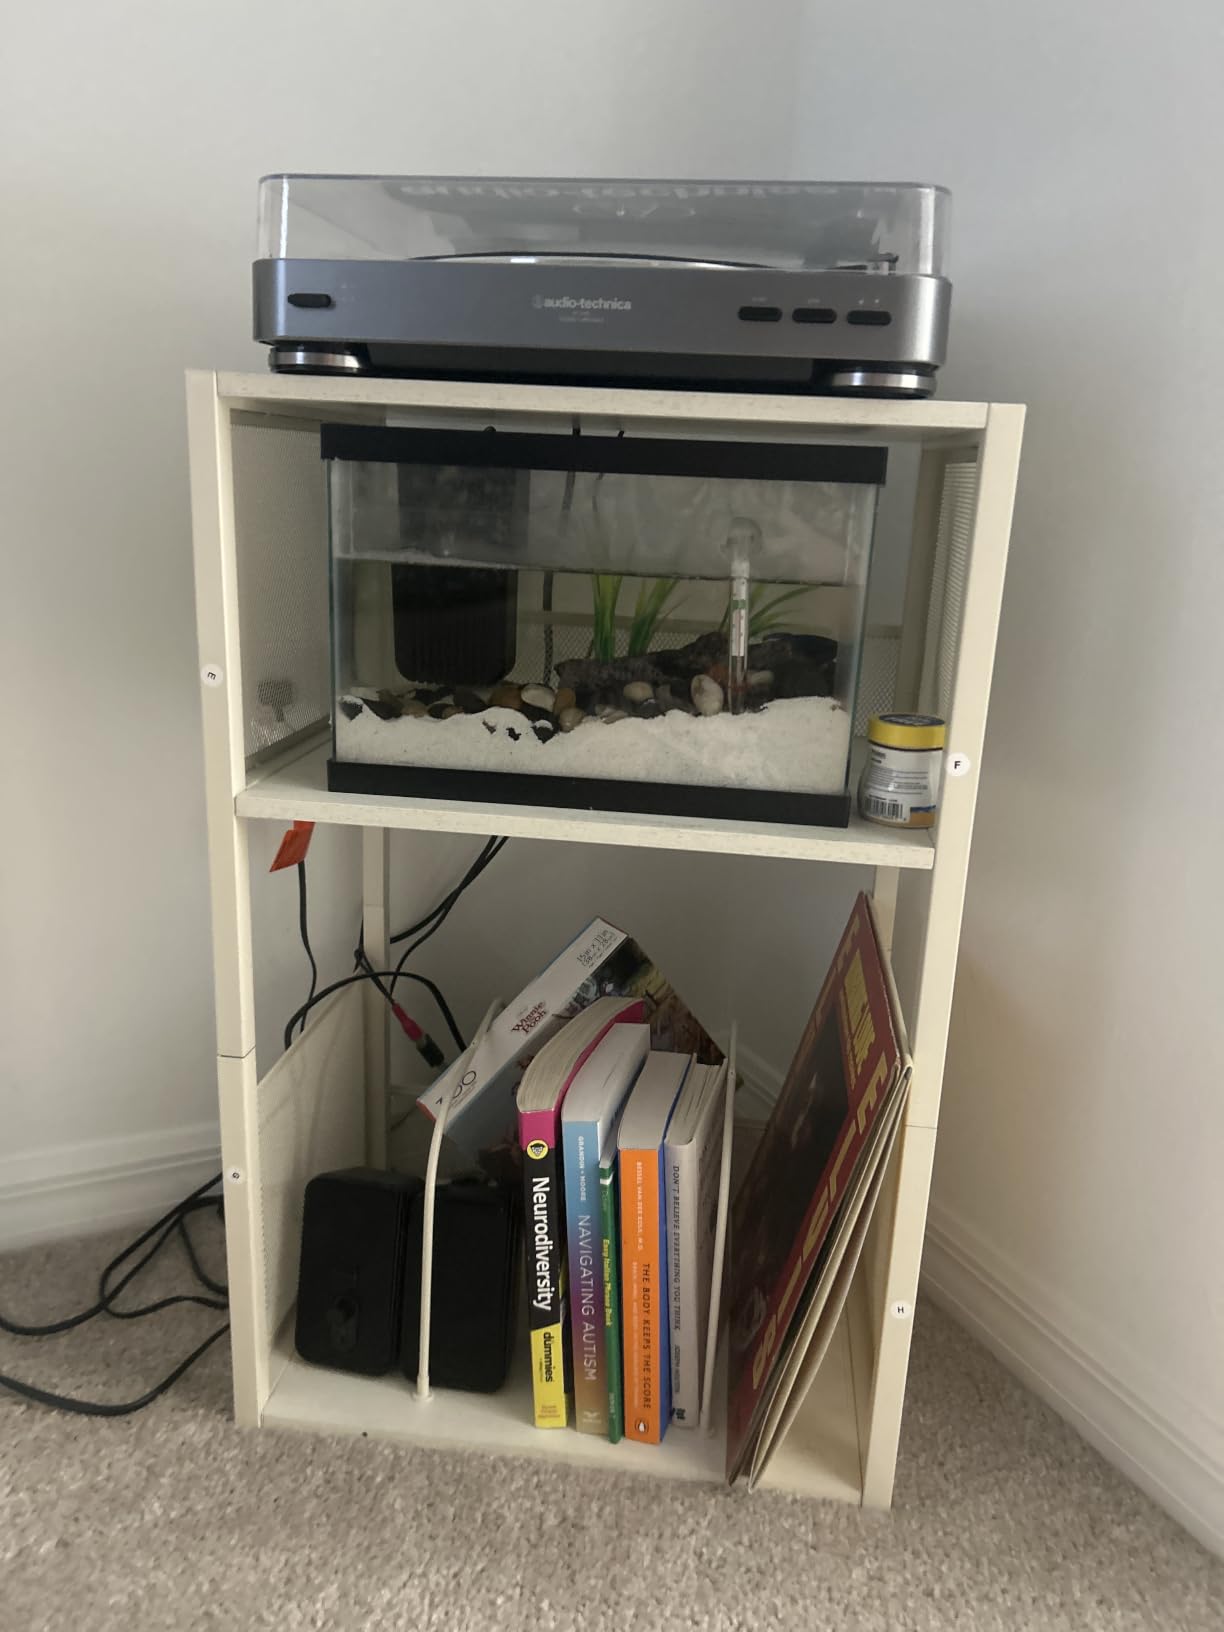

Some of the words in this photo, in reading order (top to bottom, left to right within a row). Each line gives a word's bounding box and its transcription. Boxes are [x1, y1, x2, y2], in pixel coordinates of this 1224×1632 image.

[543, 296, 632, 311] audio-technica
[512, 1001, 545, 1031] Winnie
[522, 1010, 547, 1034] Pooh
[579, 1175, 587, 1201] MOORE
[672, 1165, 681, 1194] DON'T
[673, 1196, 681, 1230] BELIEVE
[532, 1176, 555, 1311] Neurodiversity
[673, 1231, 681, 1284] EVERYTHING
[577, 1214, 596, 1316] NAVIGATING
[642, 1262, 651, 1283] THE
[642, 1287, 651, 1315] BODY
[673, 1285, 681, 1303] YOU
[642, 1318, 651, 1350] KEEPS
[542, 1331, 555, 1383] dummies
[582, 1321, 598, 1381] AUTISM
[643, 1354, 652, 1373] THE
[643, 1375, 653, 1409] SCORE
